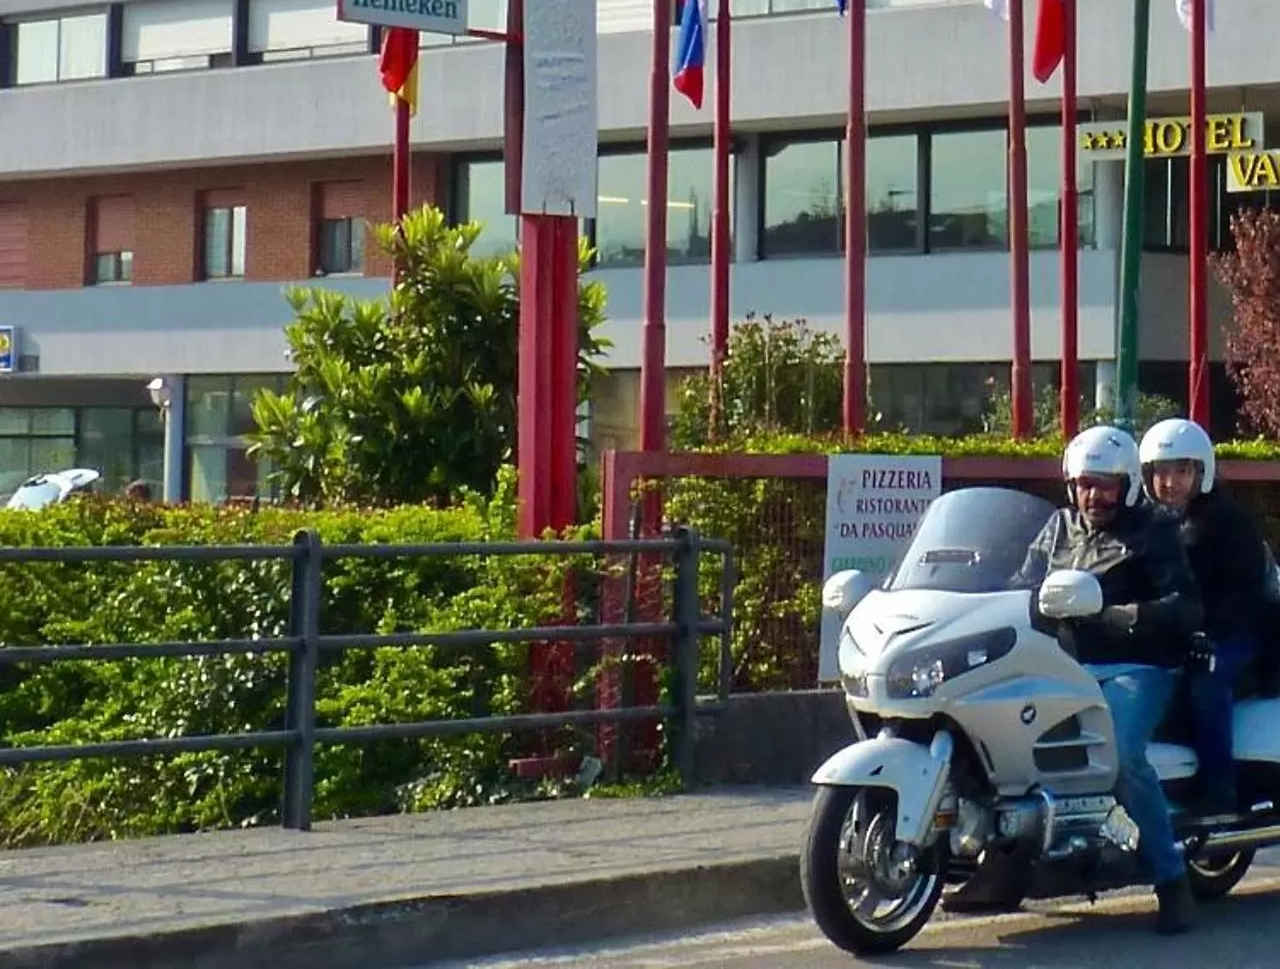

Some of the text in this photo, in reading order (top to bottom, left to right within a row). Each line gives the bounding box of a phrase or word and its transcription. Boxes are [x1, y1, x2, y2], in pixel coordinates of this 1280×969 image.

[862, 469, 932, 489] PIZZERIA
[840, 522, 917, 540] DA PASQUA
